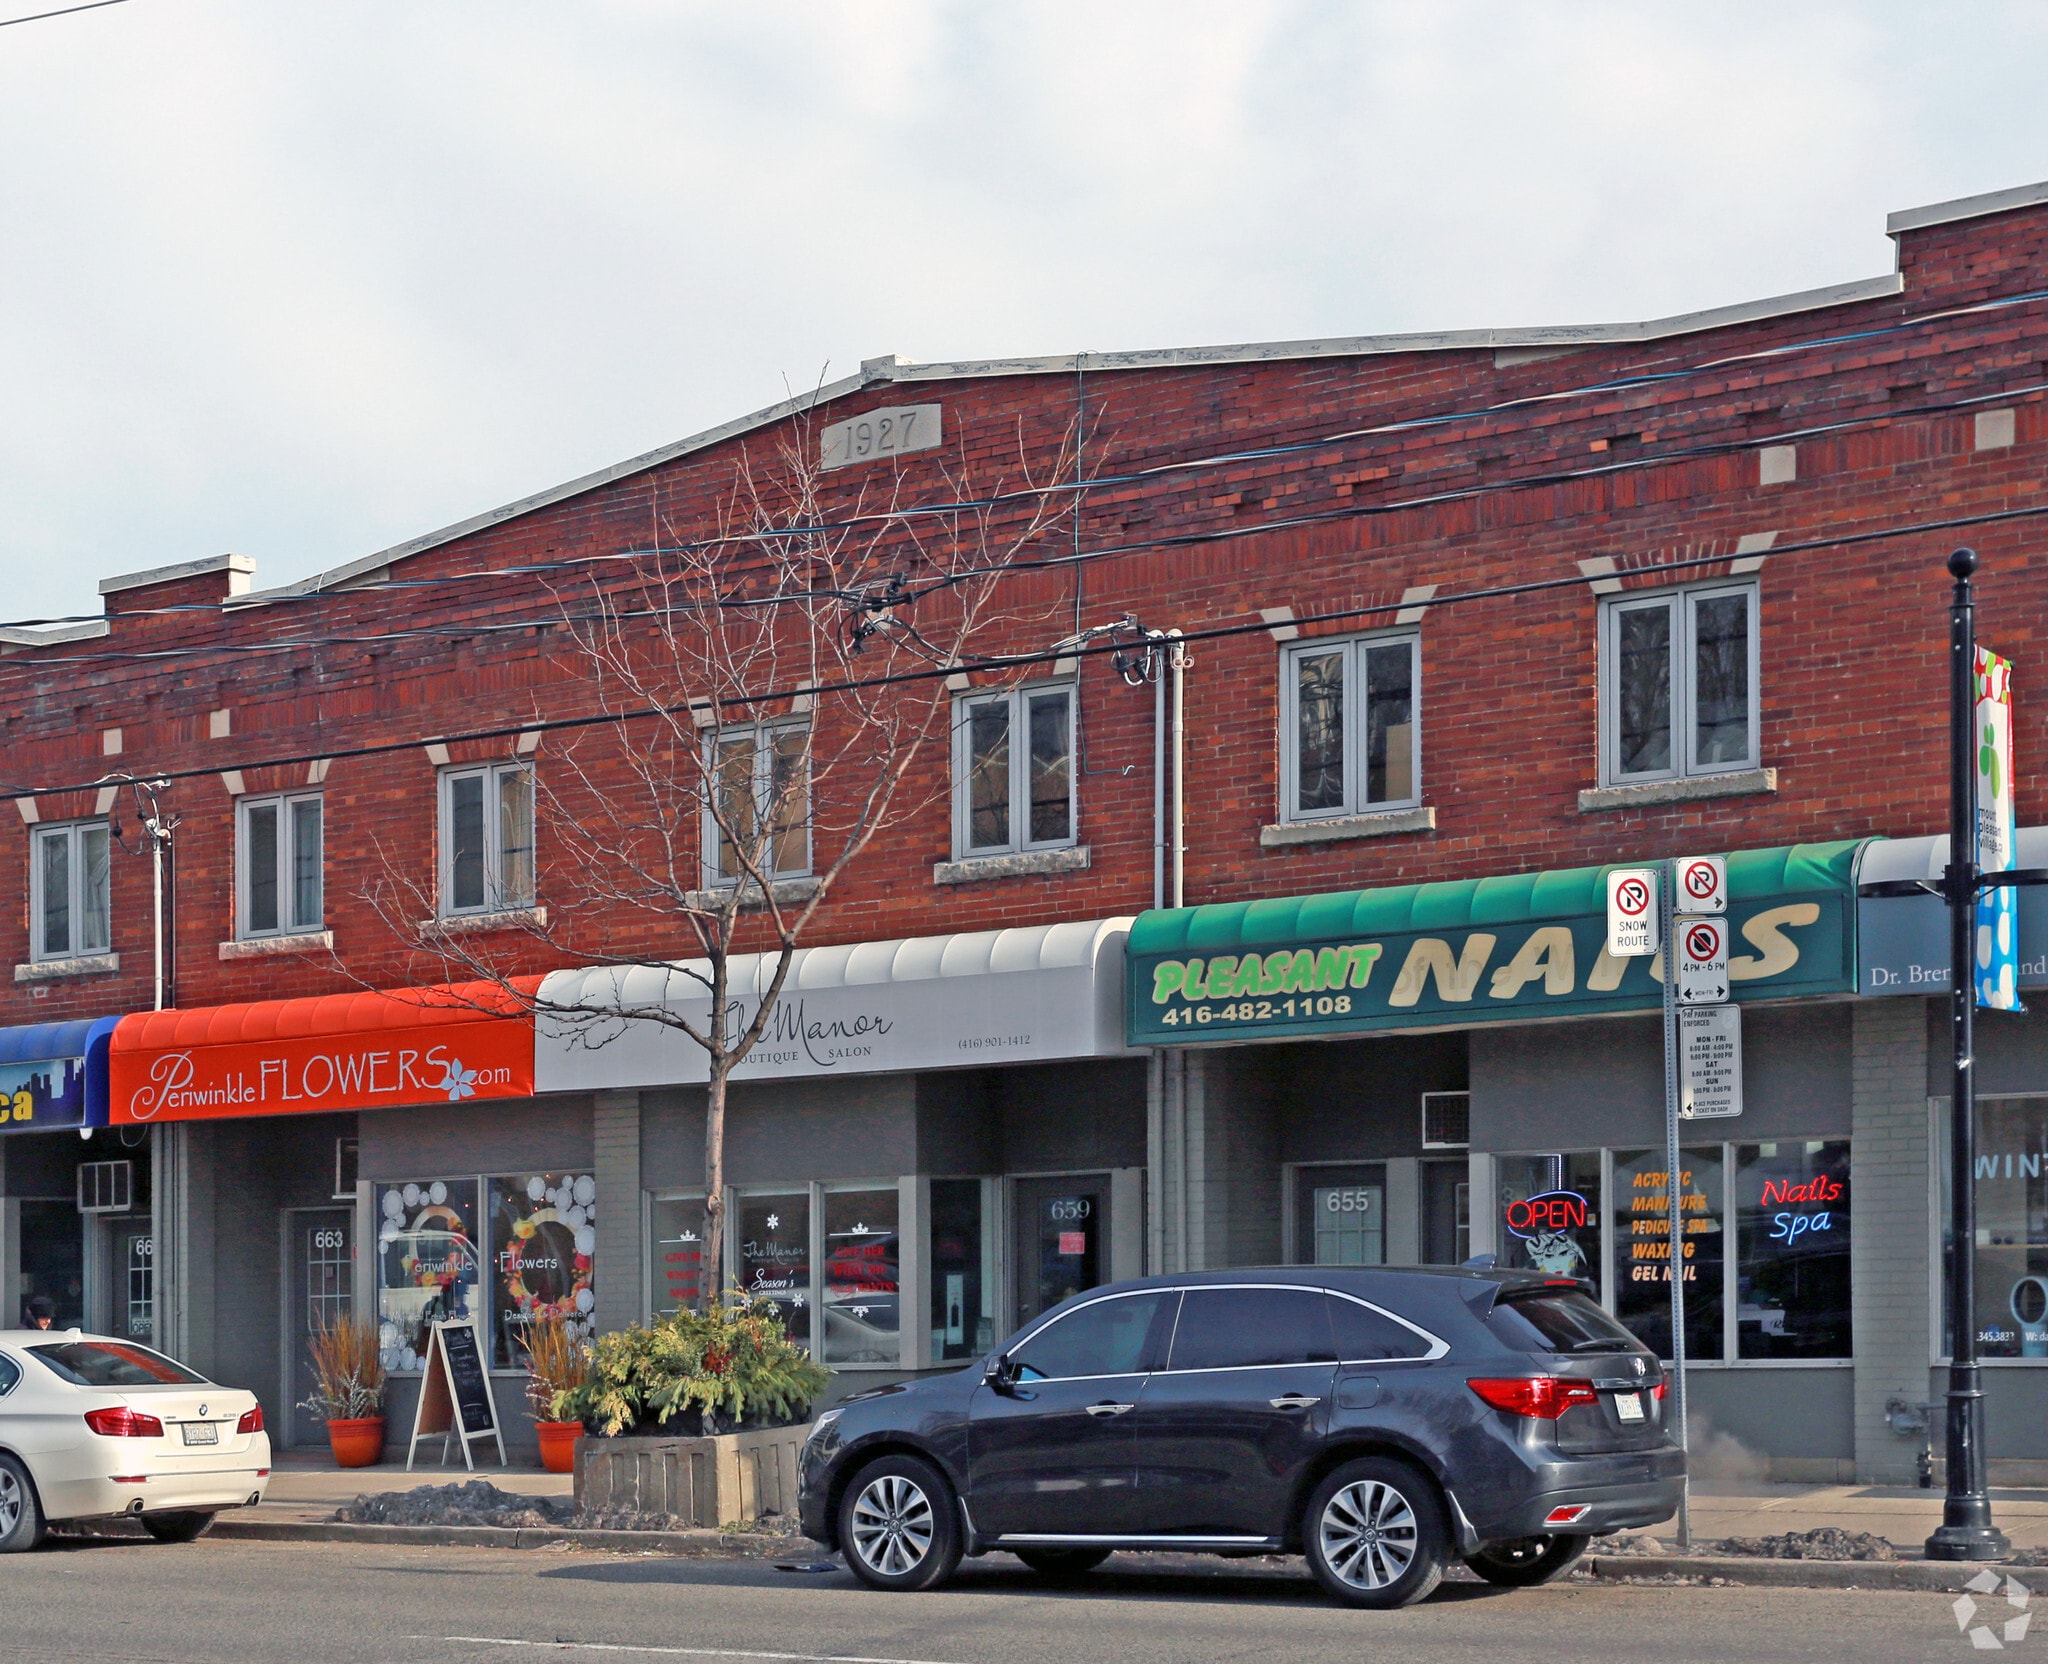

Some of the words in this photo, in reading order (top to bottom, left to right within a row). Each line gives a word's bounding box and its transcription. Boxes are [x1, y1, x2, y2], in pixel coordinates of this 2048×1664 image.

[844, 411, 917, 460] 1927
[1619, 921, 1648, 932] SNOW
[1617, 935, 1650, 947] ROUTE
[1388, 902, 1821, 1008] NAIS
[1152, 943, 1383, 1004] PLEASANT
[1682, 962, 1689, 973] 4
[1690, 963, 1700, 973] PM
[1707, 961, 1713, 972] 6
[1715, 962, 1725, 971] PM
[1870, 967, 1901, 987] Dr.
[2017, 955, 2047, 976] nd
[1162, 995, 1352, 1026] 416-482-1108
[1694, 1010, 1718, 1018] PARKING
[773, 998, 894, 1067] Manor
[1683, 1019, 1710, 1028] ENFORCED
[958, 1038, 983, 1050] (416)
[985, 1034, 1031, 1048] 901-1412
[1725, 1042, 1734, 1050] PM
[738, 1051, 800, 1065] OUTIQUE
[828, 1046, 873, 1059] SALON
[1702, 1052, 1710, 1060] PM
[130, 1049, 256, 1121] Periwinkle
[259, 1044, 451, 1102] FLOWERS
[1703, 1086, 1711, 1094] PM
[1632, 1170, 1693, 1188] ACRYIC
[1761, 1174, 1843, 1207] Nails
[1051, 1199, 1091, 1220] 659
[1327, 1191, 1369, 1212] 655
[1631, 1194, 1708, 1212] MANIURE
[1507, 1200, 1586, 1228] OPEN
[1631, 1219, 1685, 1235] PEDICUE
[1686, 1218, 1708, 1234] SPA
[1769, 1211, 1832, 1246] Spa
[136, 1239, 153, 1256] 66
[315, 1231, 344, 1248] 663
[766, 1241, 807, 1266] Manor
[863, 1245, 886, 1257] HER
[1632, 1241, 1696, 1259] WAXIG
[500, 1250, 558, 1273] Flowers
[750, 1268, 795, 1291] Season's
[1631, 1265, 1659, 1281] GEL
[1662, 1265, 1698, 1281] NIL
